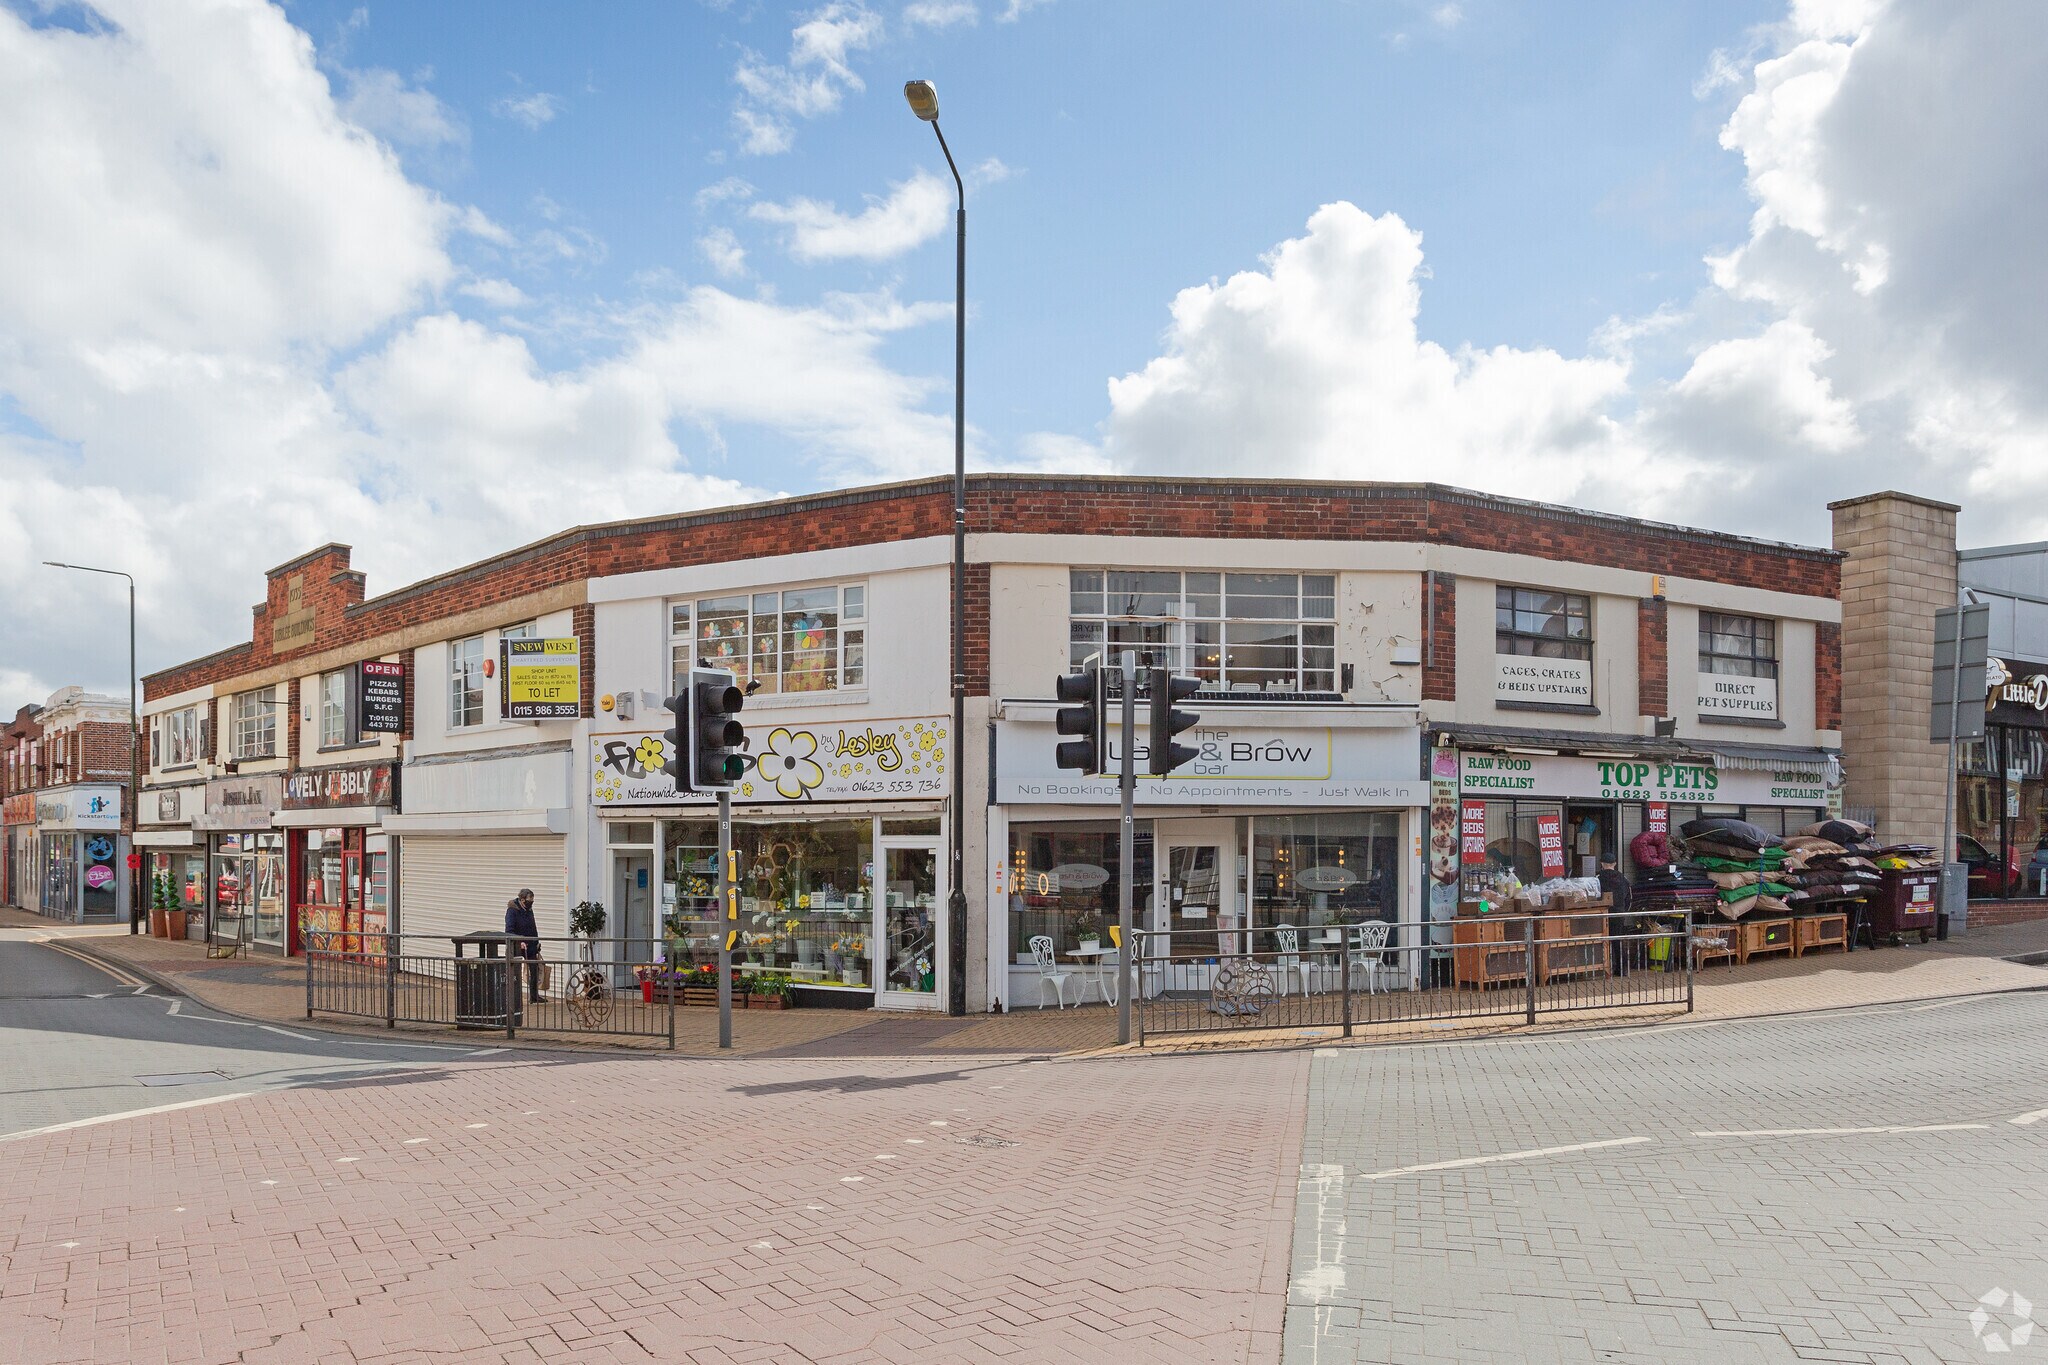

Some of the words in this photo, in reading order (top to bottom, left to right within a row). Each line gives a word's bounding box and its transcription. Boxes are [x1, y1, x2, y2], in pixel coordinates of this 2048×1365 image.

[520, 642, 544, 652] NEW
[546, 642, 574, 651] WEST
[366, 664, 399, 675] OPEN
[1502, 665, 1539, 679] CAGES,
[1541, 668, 1581, 680] CRATES
[369, 680, 397, 688] PIZZAS
[1508, 681, 1535, 692] BEDS
[1538, 684, 1588, 695] UPSTAIRS
[1715, 682, 1755, 695] DIRECT
[368, 687, 399, 696] KEBABS
[528, 688, 541, 698] TO
[544, 687, 560, 697] LET
[2003, 683, 2035, 704] Little
[365, 695, 402, 703] BURGERS
[1697, 696, 1719, 707] PET
[1721, 697, 1773, 711] SUPPLIES
[514, 706, 533, 715] 0115
[535, 705, 552, 714] 986
[555, 705, 575, 715] 3555
[368, 714, 399, 722] T:01623
[1194, 728, 1228, 741] the
[820, 733, 835, 753] by
[835, 727, 902, 772] Lesley
[1200, 742, 1222, 762] &
[1194, 762, 1228, 775] bar
[1467, 756, 1494, 770] RAW
[1497, 758, 1532, 771] FOOD
[1464, 775, 1535, 789] SPECIALIST
[1598, 762, 1650, 787] TOP
[1656, 764, 1719, 790] PETS
[1774, 771, 1794, 782] RAW
[1796, 773, 1822, 784] FOOD
[283, 775, 323, 799] LOVELY
[325, 769, 372, 799] JUBBLY
[851, 780, 885, 793] 01623
[887, 781, 914, 793] 553
[918, 778, 941, 793] 736
[1018, 784, 1041, 796] No
[1046, 783, 1122, 797] Bookings
[1151, 785, 1173, 796] No
[1178, 785, 1292, 798] Appointments
[1318, 787, 1350, 798] Just
[1354, 787, 1391, 797] Walk
[1396, 788, 1409, 797] In
[627, 783, 677, 800] Nationwide
[1601, 789, 1651, 799] 01623
[1660, 790, 1715, 801] 554325
[1770, 787, 1825, 799] SPECIALIST
[1463, 808, 1484, 820] MORE
[1649, 808, 1667, 820] MORE
[1463, 822, 1484, 834] BEDS
[1539, 822, 1560, 835] MORE
[1462, 836, 1485, 853] UPSTAIRS
[1541, 837, 1561, 849] BEDS
[1543, 850, 1563, 867] UPSTAIRS
